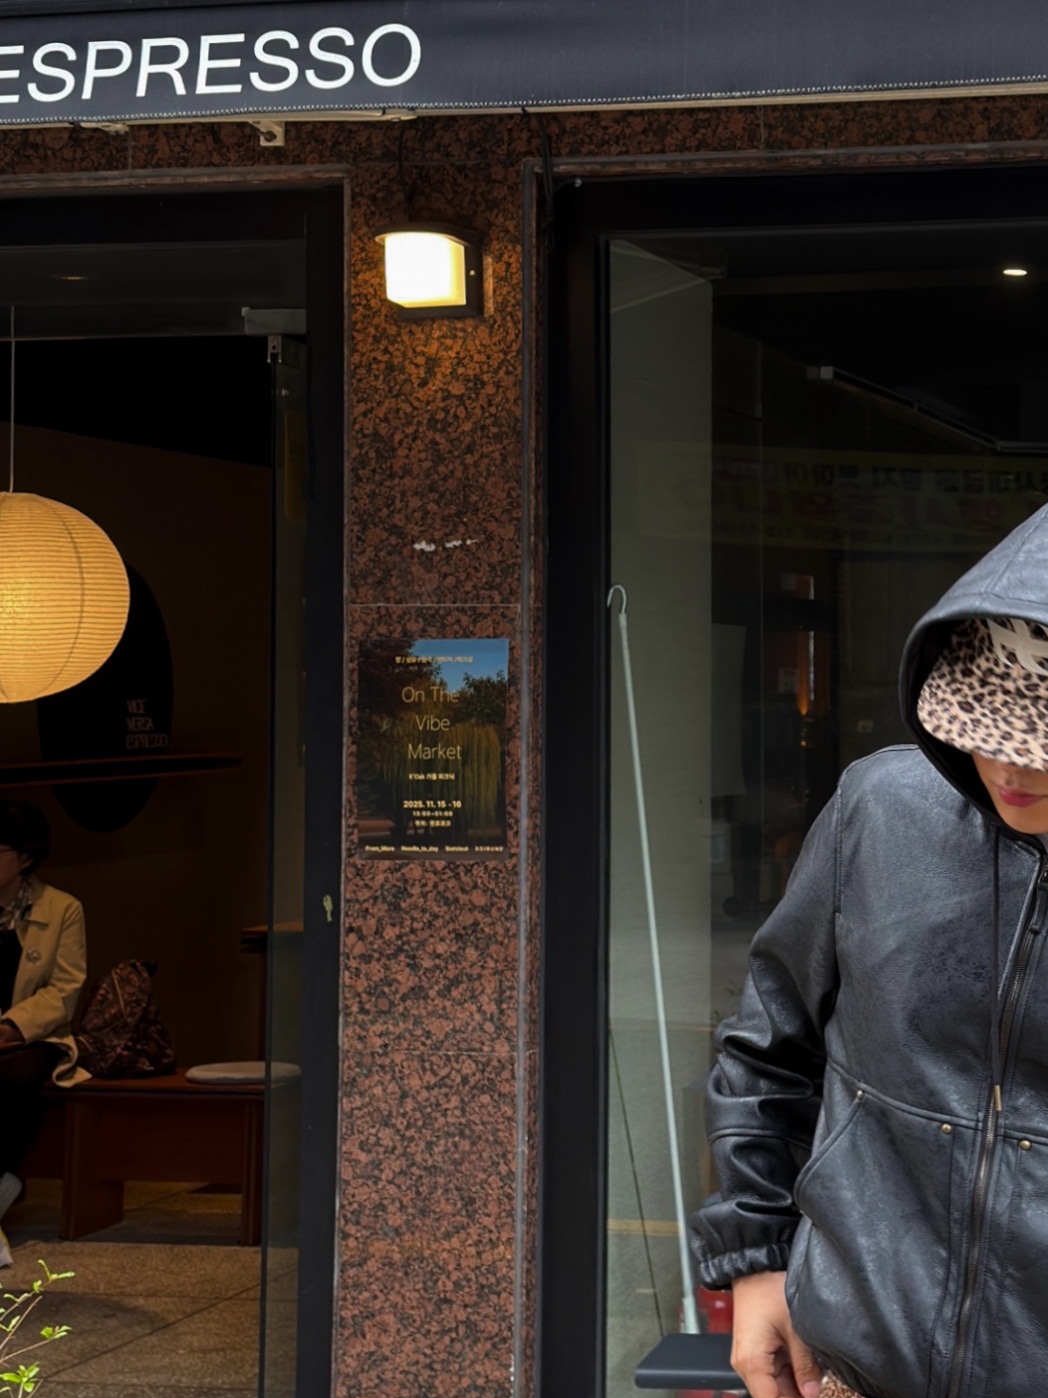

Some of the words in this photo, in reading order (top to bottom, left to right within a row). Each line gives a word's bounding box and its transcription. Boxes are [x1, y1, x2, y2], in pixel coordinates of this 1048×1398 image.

[402, 686, 425, 703] On
[430, 686, 459, 702] The
[127, 699, 146, 713] VICE
[127, 717, 154, 731] VERSA
[416, 714, 450, 731] Vibe
[408, 743, 461, 760] Market
